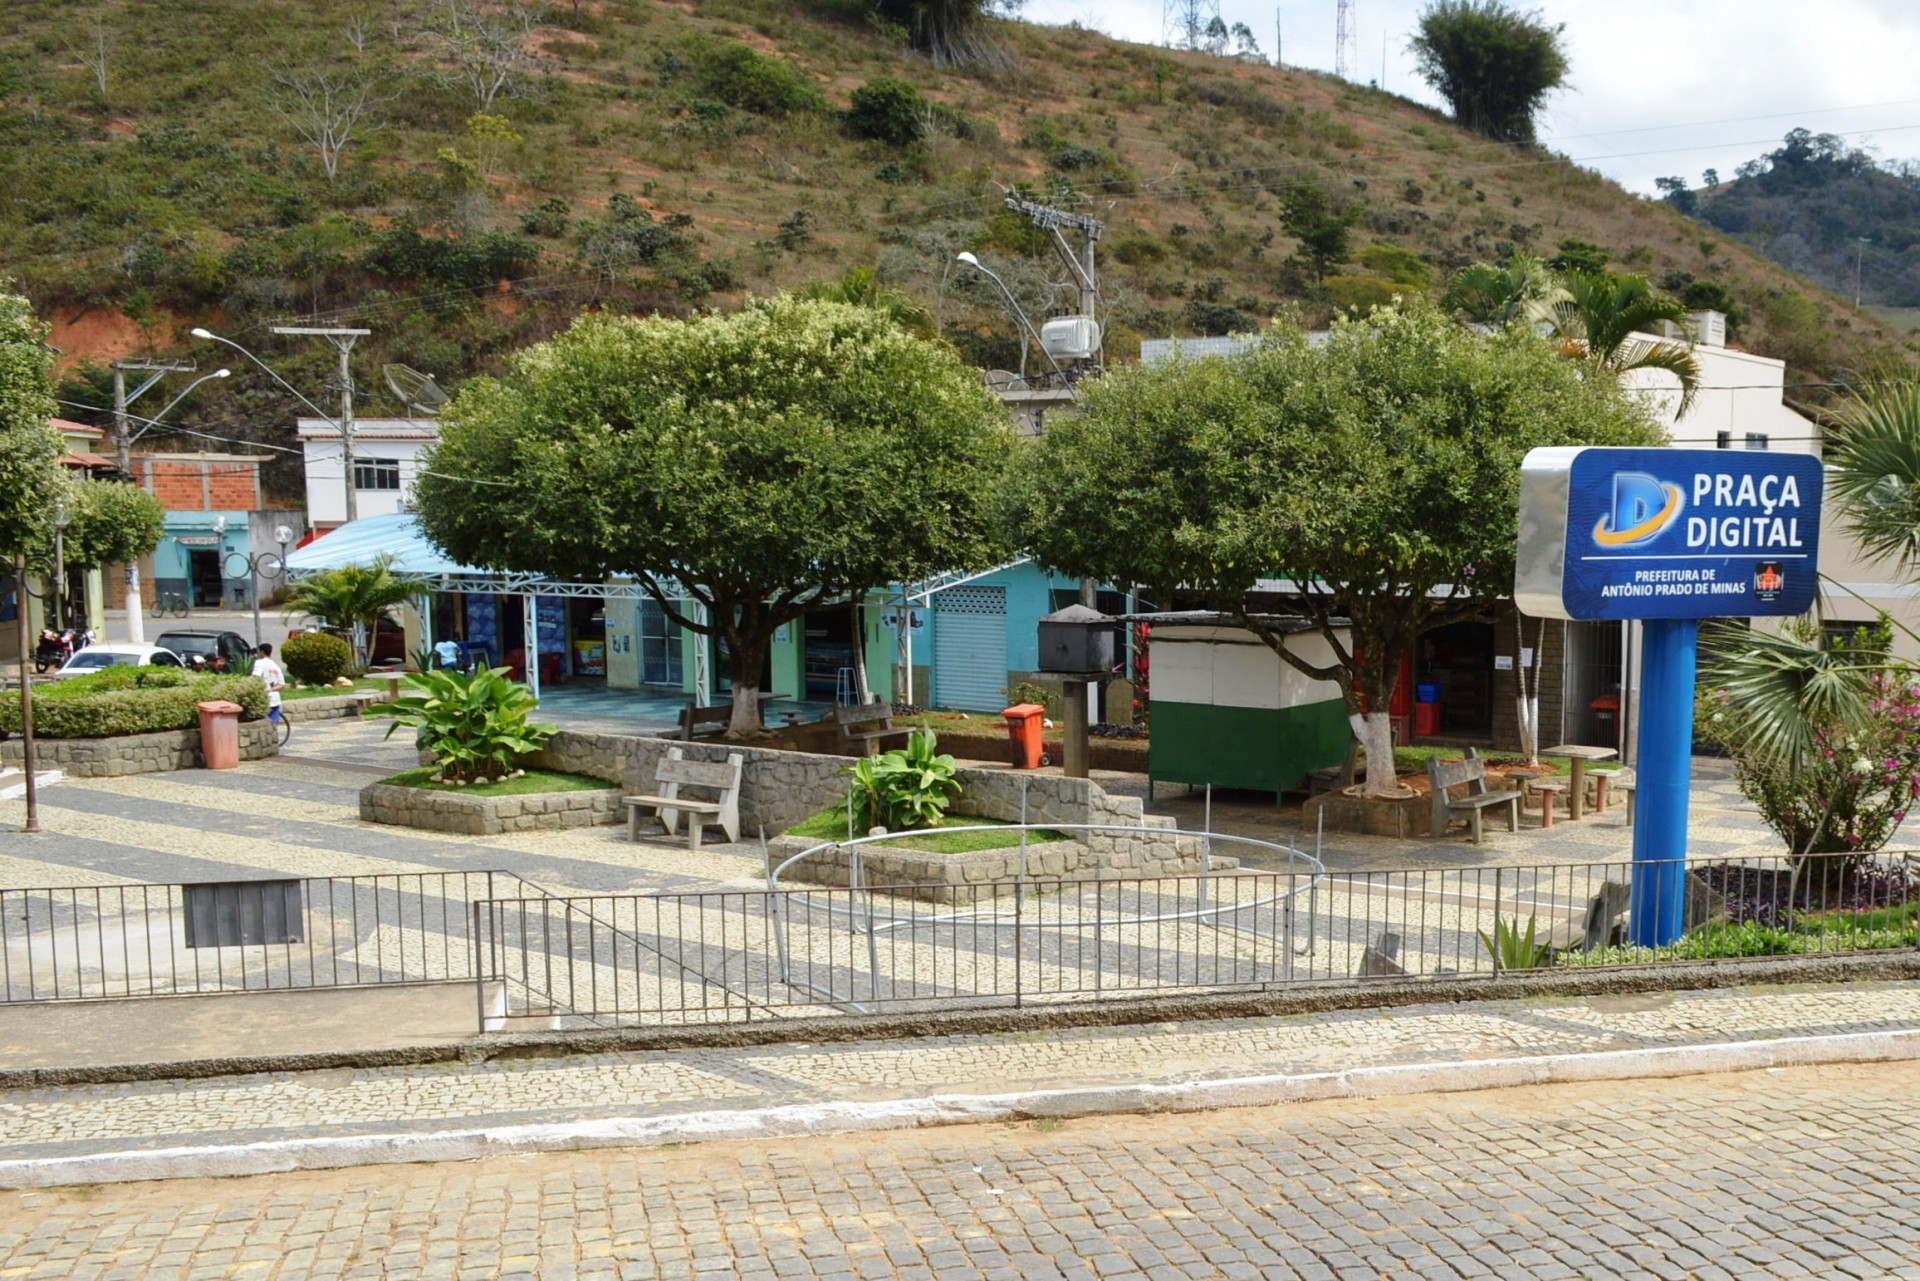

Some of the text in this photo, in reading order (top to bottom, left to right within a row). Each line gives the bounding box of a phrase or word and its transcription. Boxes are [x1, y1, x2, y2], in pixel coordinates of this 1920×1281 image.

[1693, 474, 1800, 515] PRAÇA
[1687, 517, 1803, 547] DIGITAL
[1635, 569, 1716, 582] PREFEITURA DE
[1601, 582, 1653, 597] ANTÔNIO
[1655, 584, 1692, 595] PRADO
[1694, 583, 1709, 594] DE
[1710, 582, 1746, 594] MINAS
